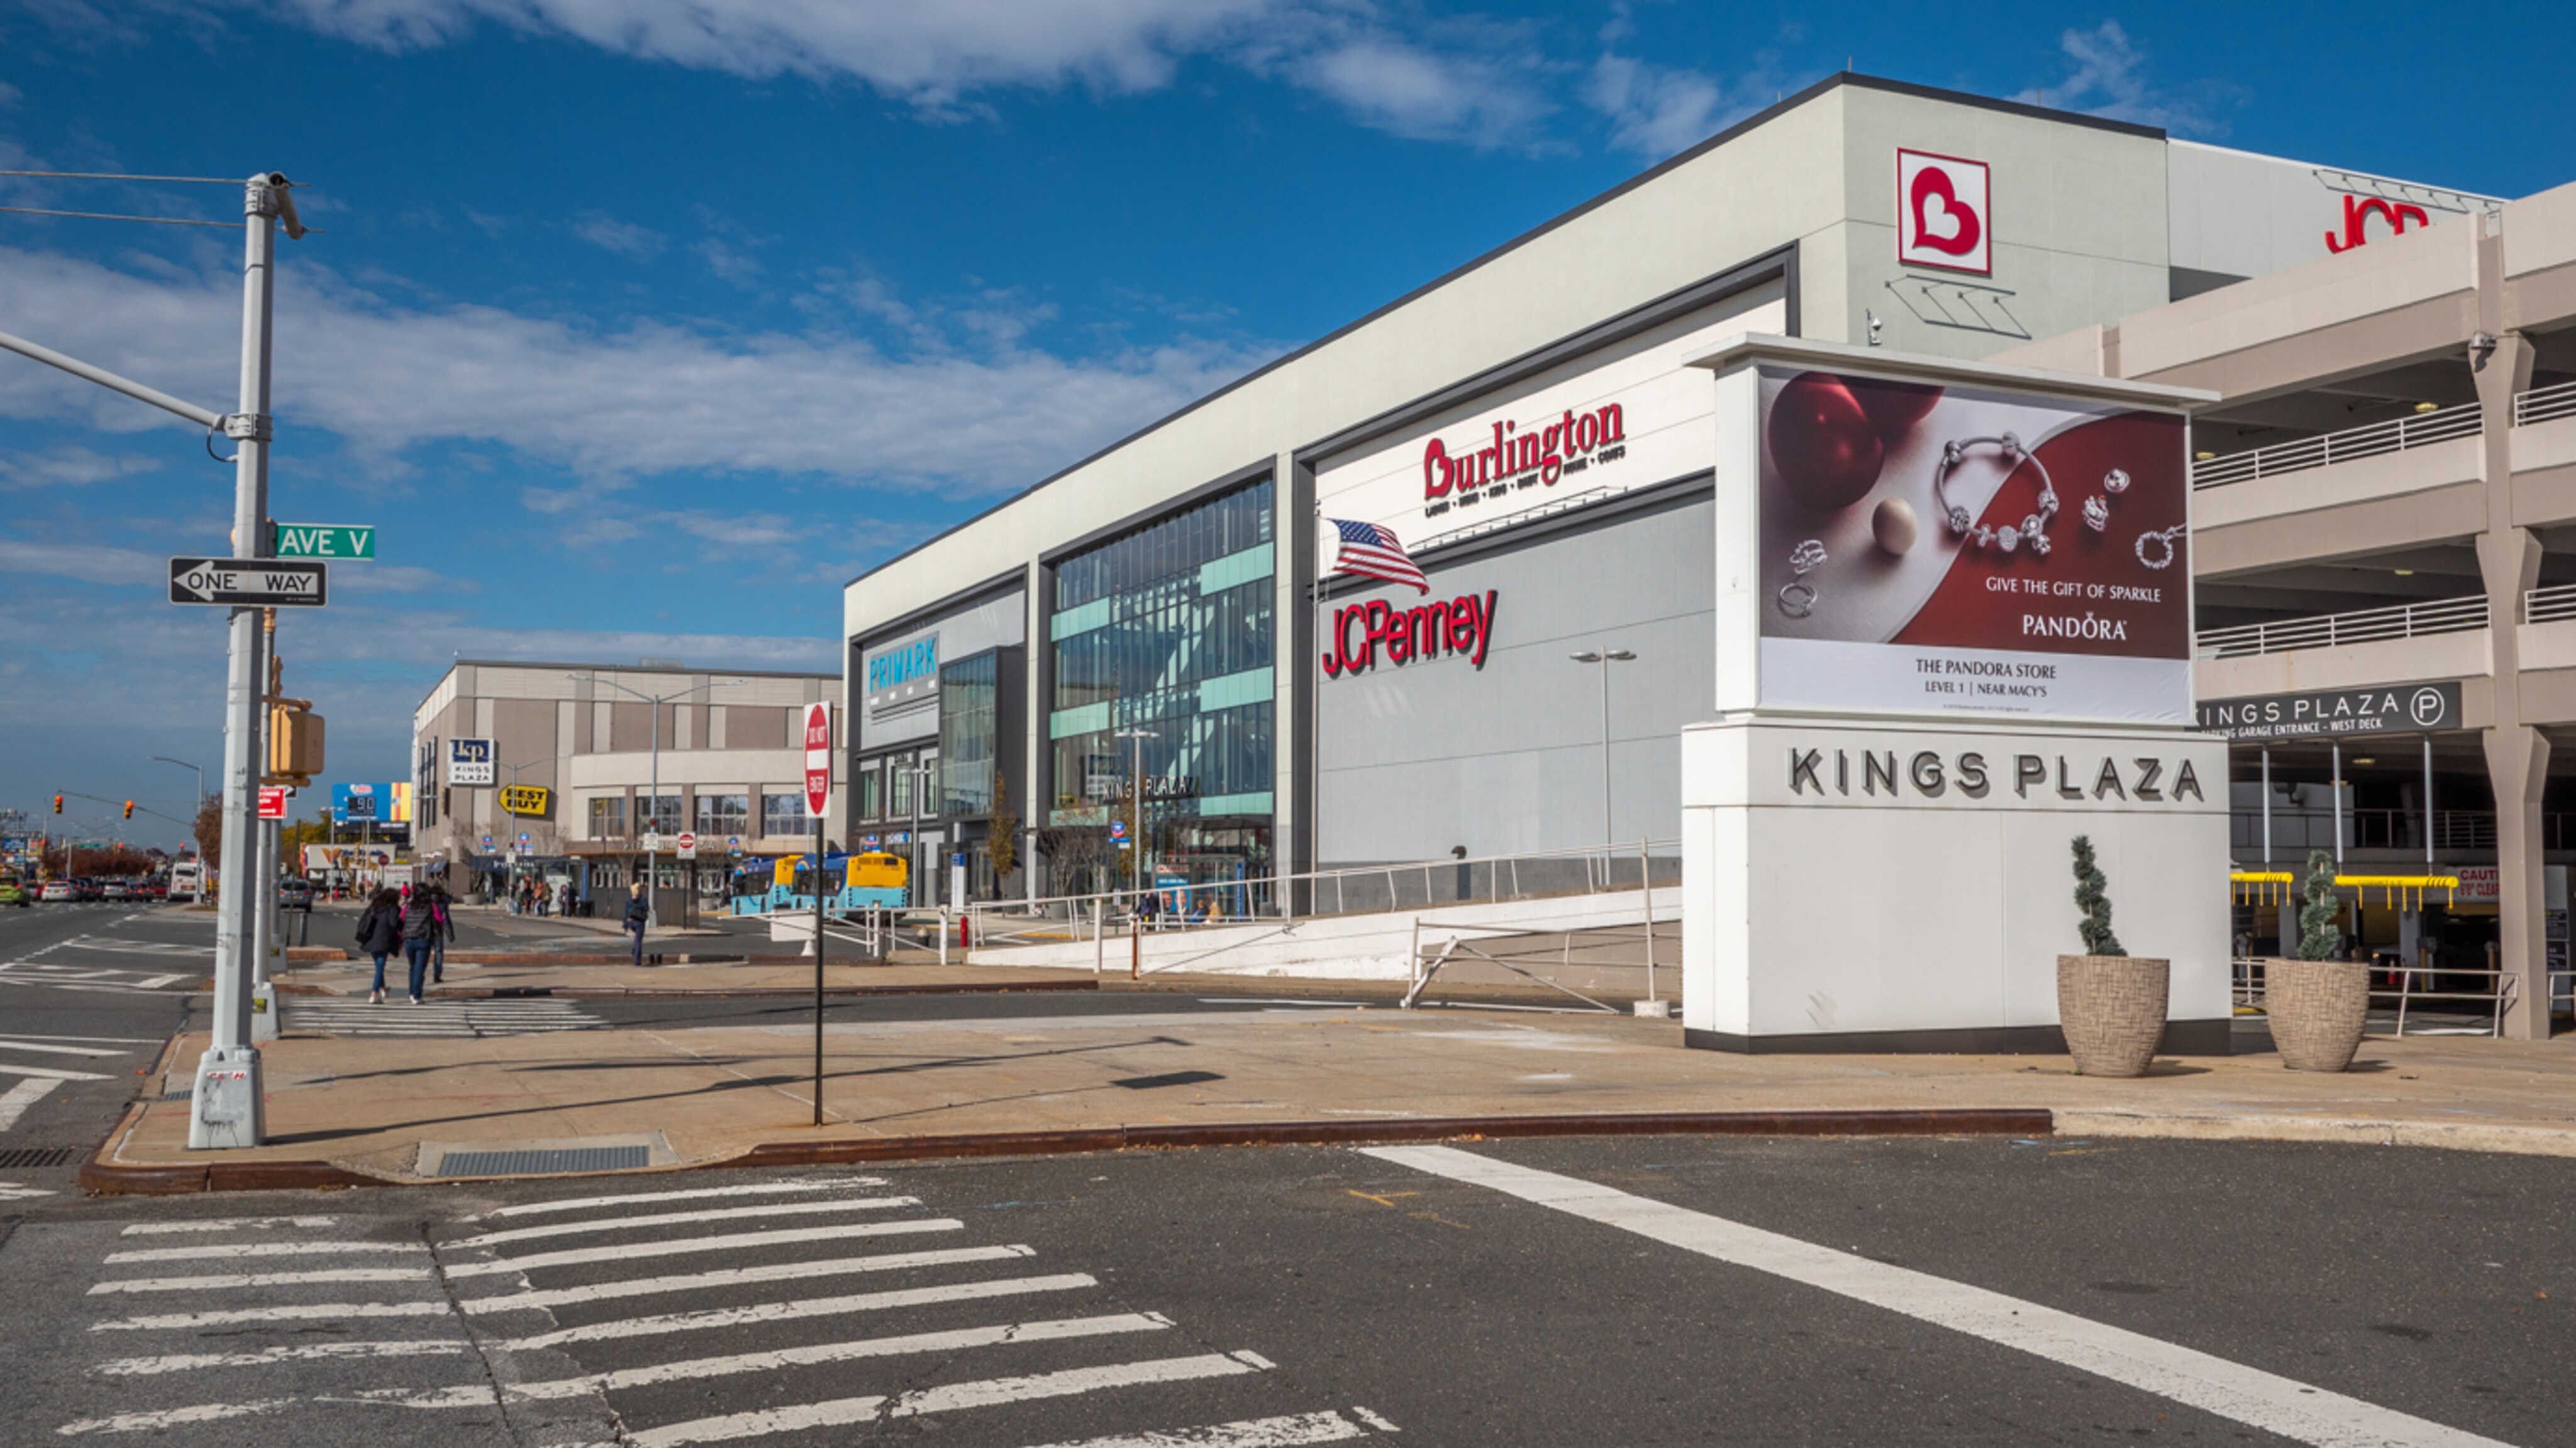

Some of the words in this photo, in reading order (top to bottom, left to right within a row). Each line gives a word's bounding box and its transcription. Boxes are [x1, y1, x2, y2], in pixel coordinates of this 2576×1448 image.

[1424, 402, 1626, 499] Burlington
[279, 529, 335, 555] AVE
[349, 531, 369, 556] V
[188, 572, 238, 590] ONE
[265, 574, 312, 592] WAY
[1986, 577, 2018, 592] GIVE
[2023, 579, 2048, 595] THE
[2053, 581, 2083, 597] GIFT
[2087, 583, 2106, 598] OF
[2109, 585, 2162, 602] SPARKLE
[1322, 590, 1497, 676] JCPenney
[869, 638, 936, 694] PRIMARK
[1916, 659, 1942, 673] THE
[1945, 660, 2012, 677] PANDORA
[2016, 664, 2057, 679] STORE
[1925, 681, 1955, 694] LEVEL
[1959, 683, 1964, 694] 1
[1978, 683, 2006, 695] NEAR
[2009, 685, 2048, 697] MACY'S
[2295, 693, 2399, 720] PLAZA
[2238, 724, 2273, 738] GARAGE
[2275, 722, 2320, 735] ENTRANCE
[2330, 719, 2356, 732] WEST
[2359, 717, 2383, 729] DECK
[458, 741, 485, 763] kp
[1789, 747, 1991, 797] KINGS
[2014, 755, 2203, 801] PLAZA
[506, 788, 545, 800] BEST
[1104, 780, 1136, 799] KING
[1146, 777, 1187, 796] PLAZA
[506, 799, 540, 810] BUY
